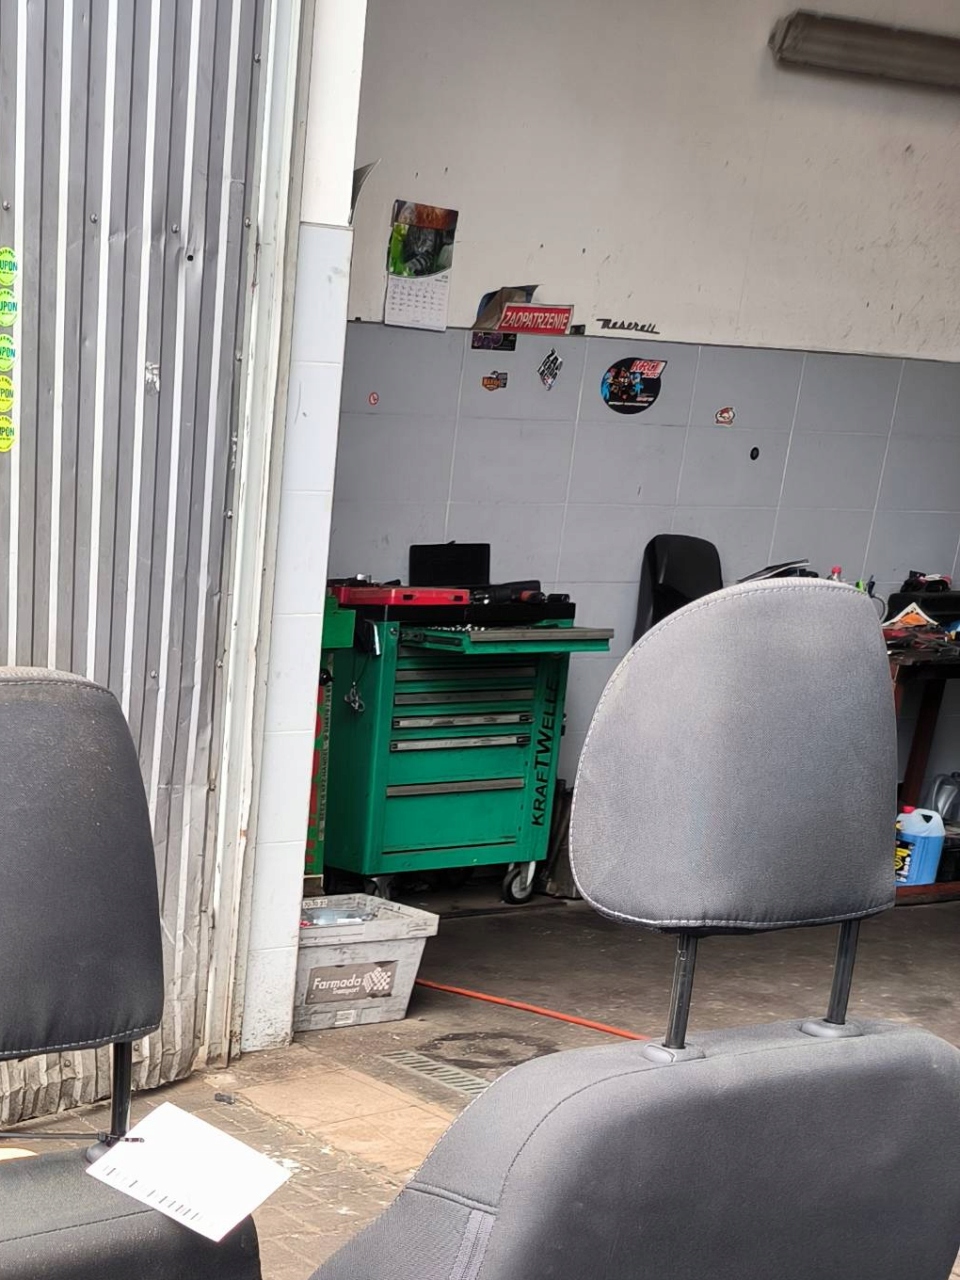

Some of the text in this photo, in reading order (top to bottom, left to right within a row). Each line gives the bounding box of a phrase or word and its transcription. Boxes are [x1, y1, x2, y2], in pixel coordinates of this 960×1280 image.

[501, 311, 570, 330] ZAOPATRZENIE
[531, 677, 560, 828] KRAFTWELLE
[313, 974, 362, 990] Farmada
